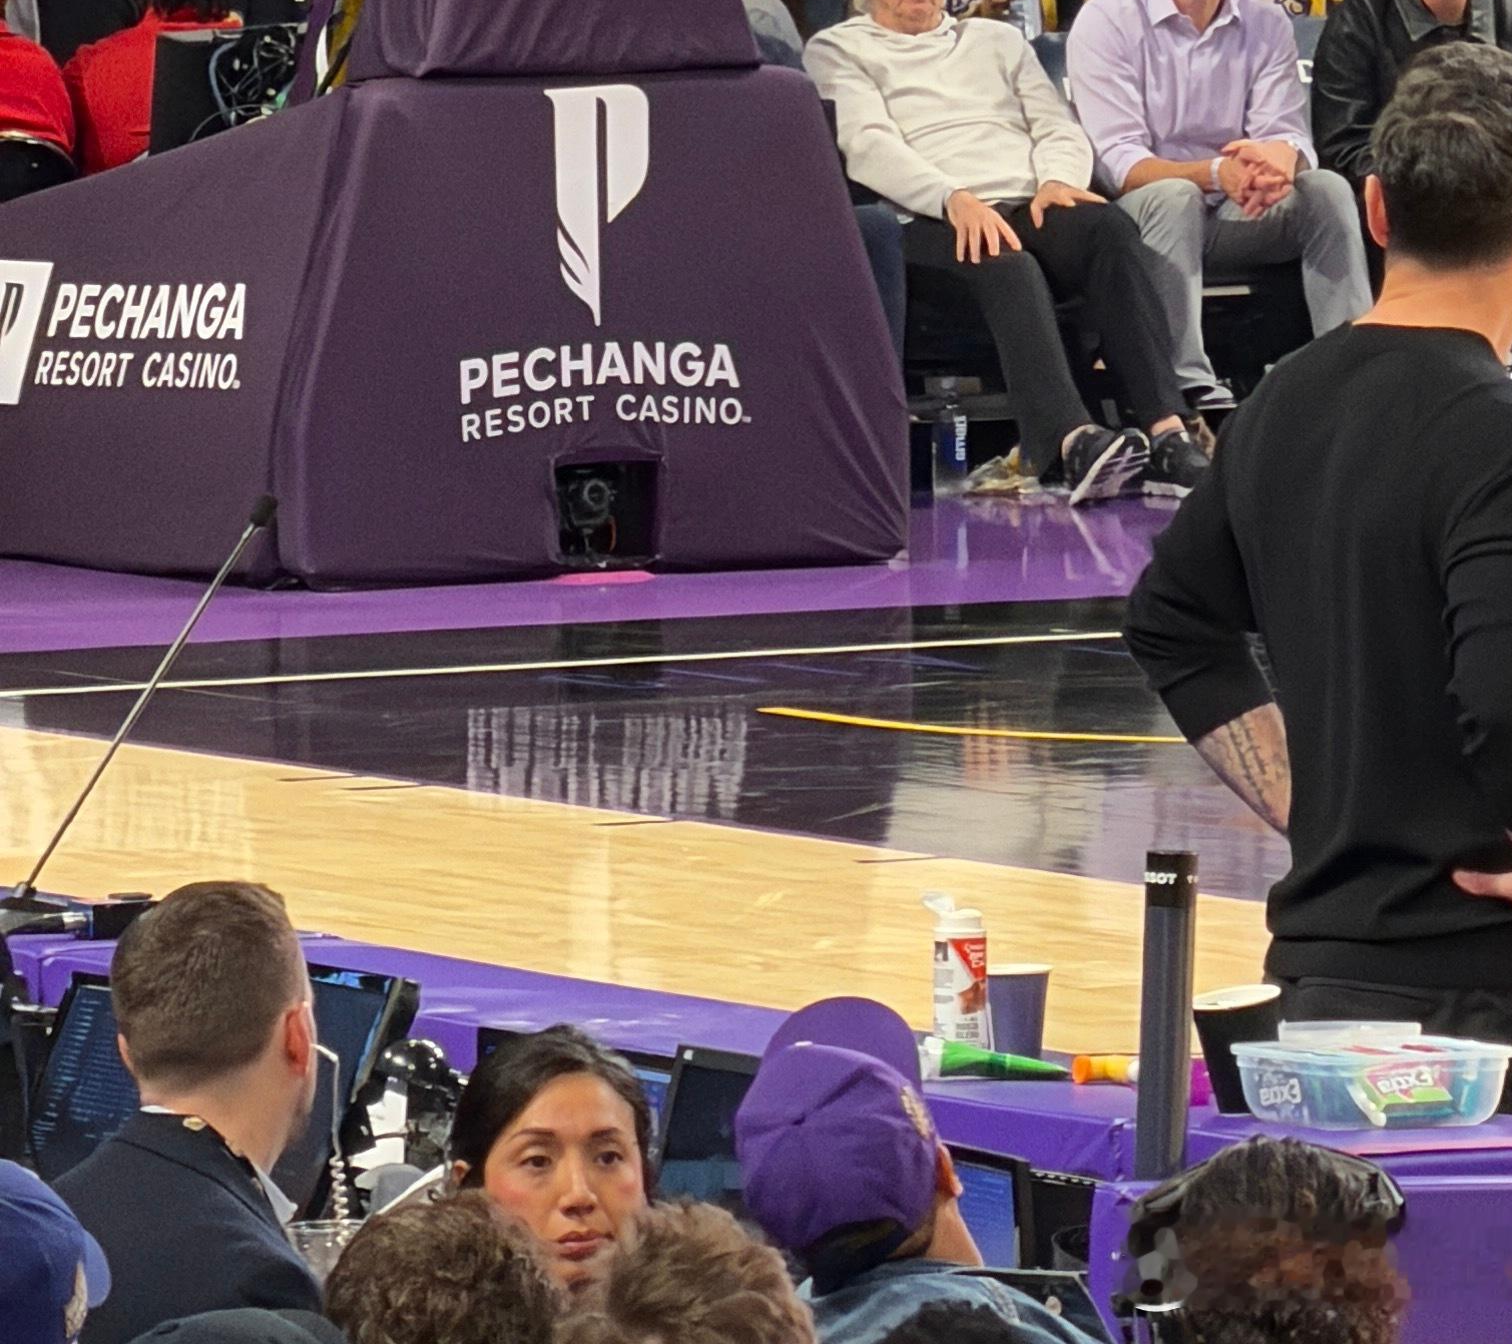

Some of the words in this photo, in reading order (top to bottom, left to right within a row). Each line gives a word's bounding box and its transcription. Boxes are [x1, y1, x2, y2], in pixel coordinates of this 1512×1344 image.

[47, 282, 247, 340] PECHANGA
[34, 350, 135, 388] RESORT
[460, 340, 740, 405] PECHANGA
[461, 395, 595, 443] RESORT
[1259, 1077, 1302, 1107] Extra
